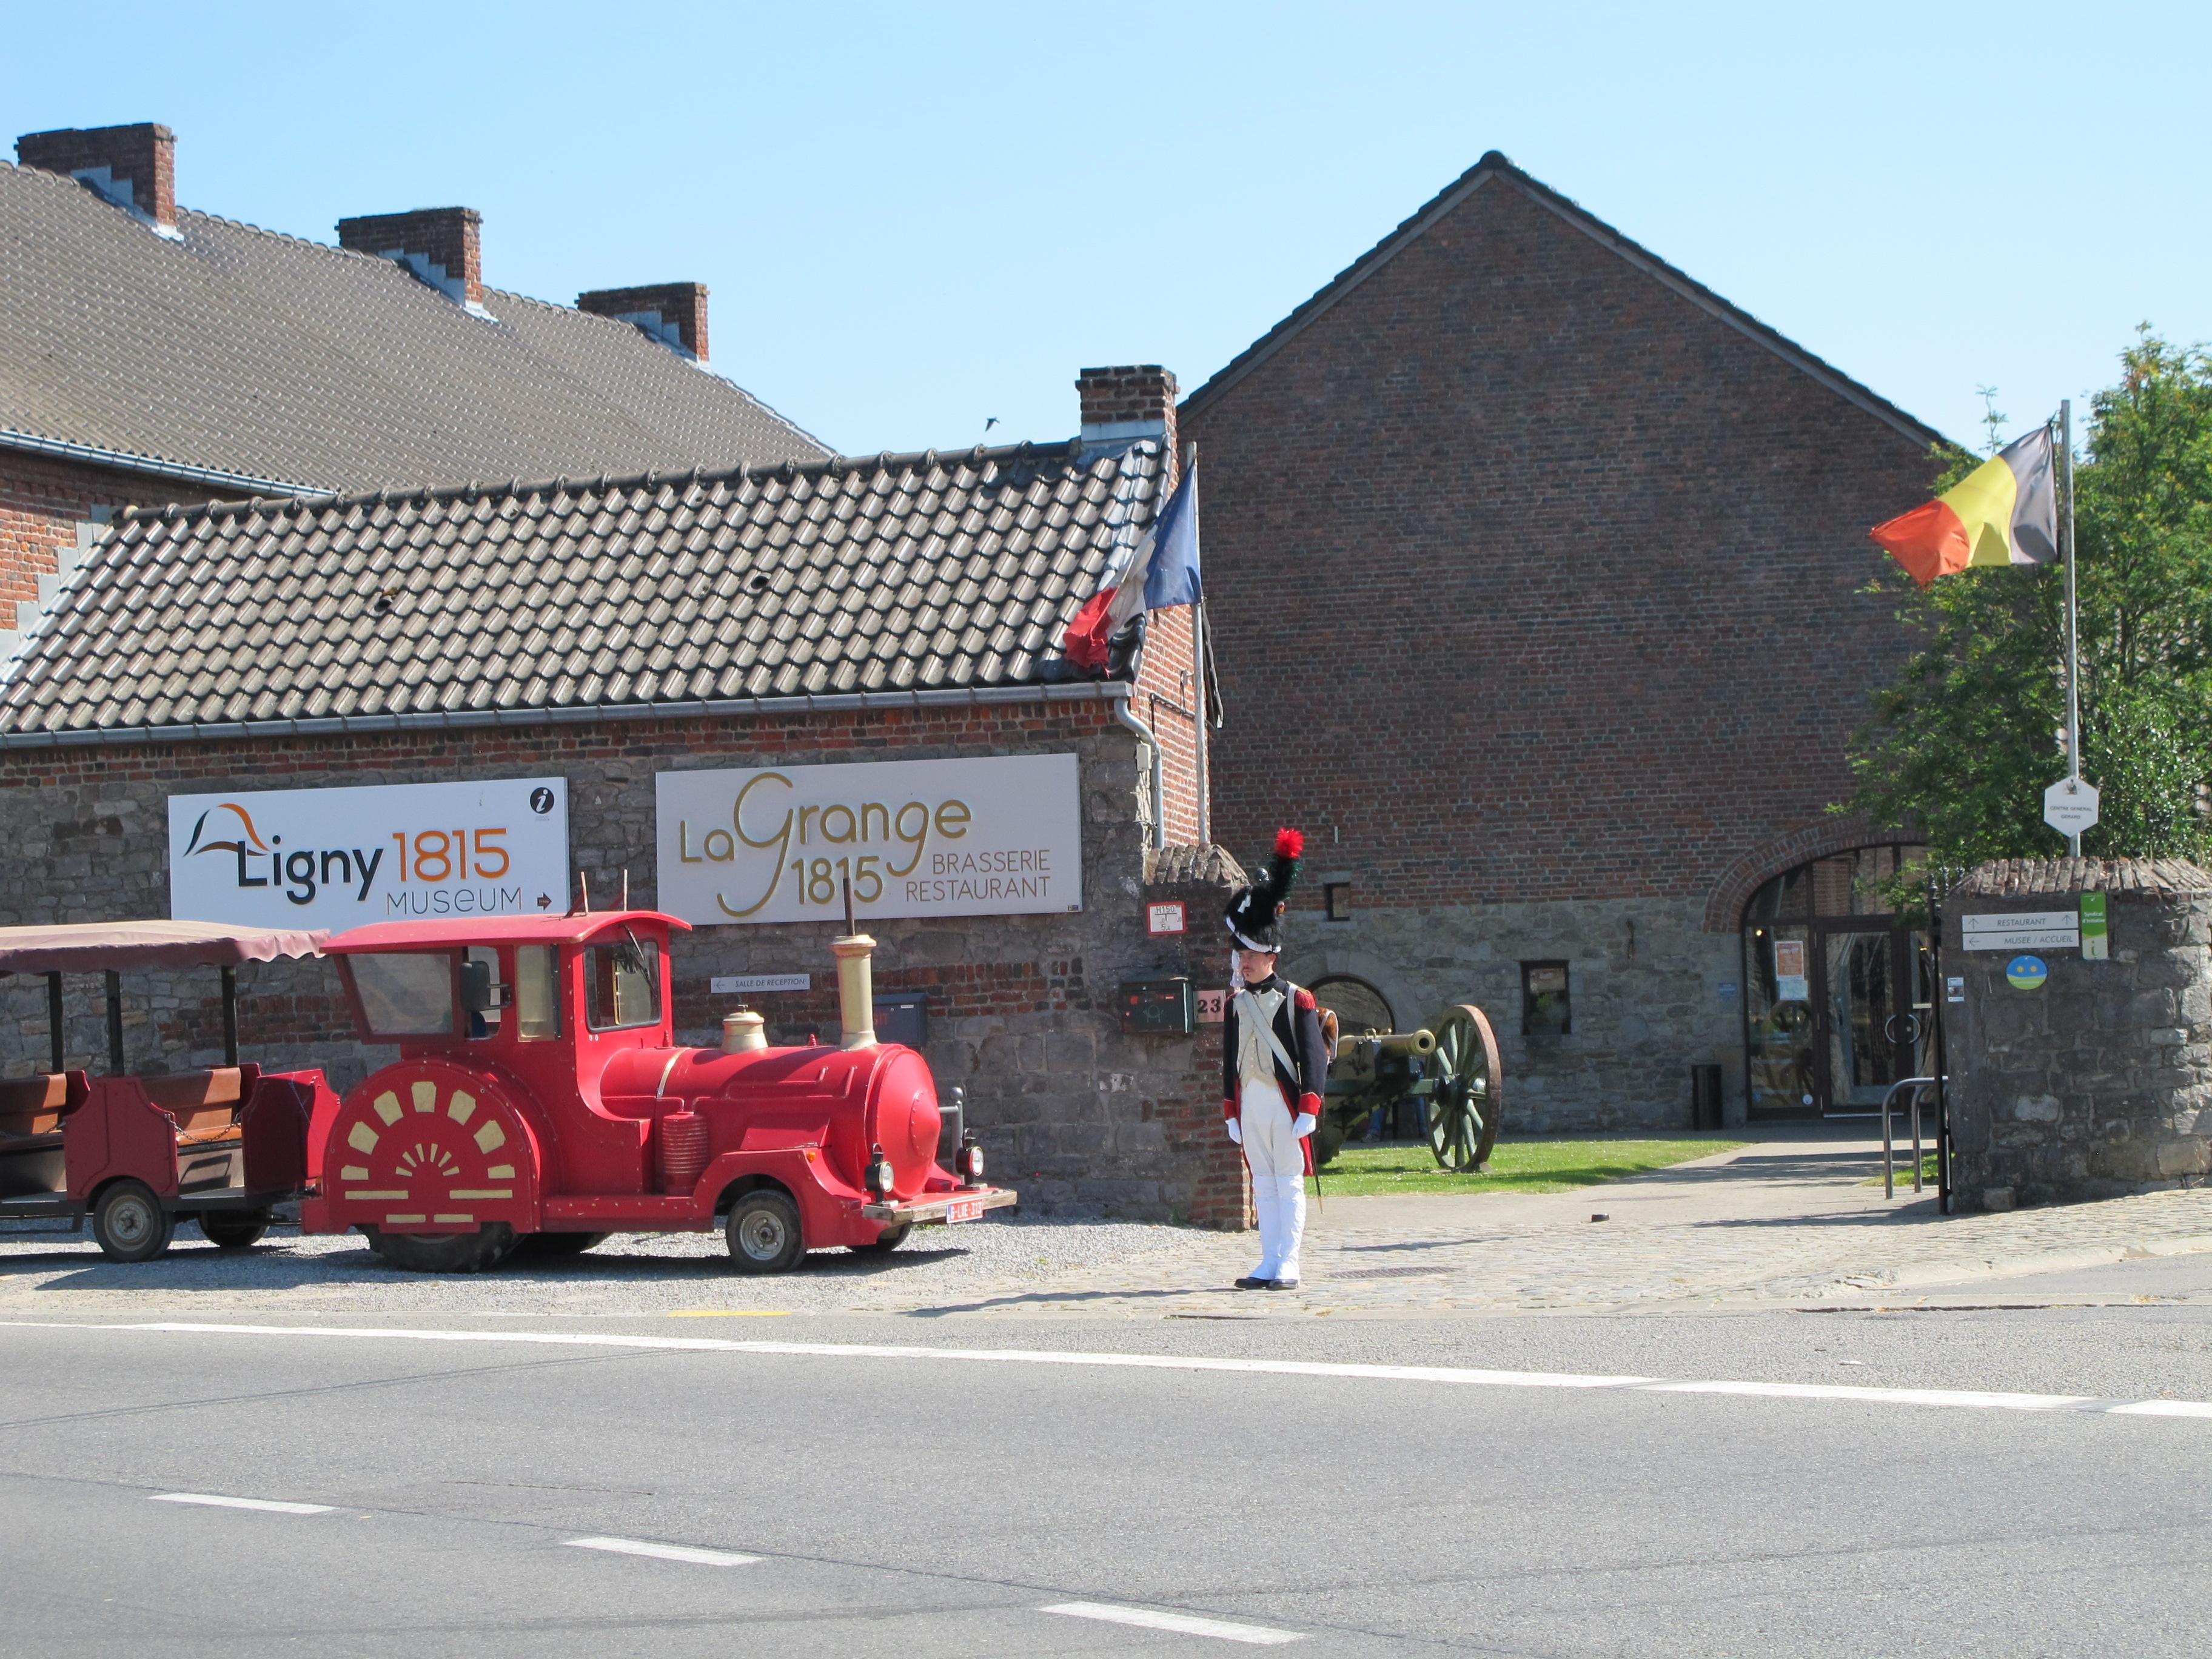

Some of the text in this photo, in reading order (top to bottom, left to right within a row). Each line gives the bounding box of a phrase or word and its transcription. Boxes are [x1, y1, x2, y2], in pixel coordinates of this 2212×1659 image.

[680, 772, 971, 917] La Grange
[238, 827, 511, 905] Ligny 1815
[933, 850, 1051, 875] BRASSERIE
[905, 876, 1051, 902] RESTAURANT
[1156, 905, 1175, 914] H150
[1997, 918, 2046, 927] RESTAURANT
[1197, 999, 1221, 1013] 23
